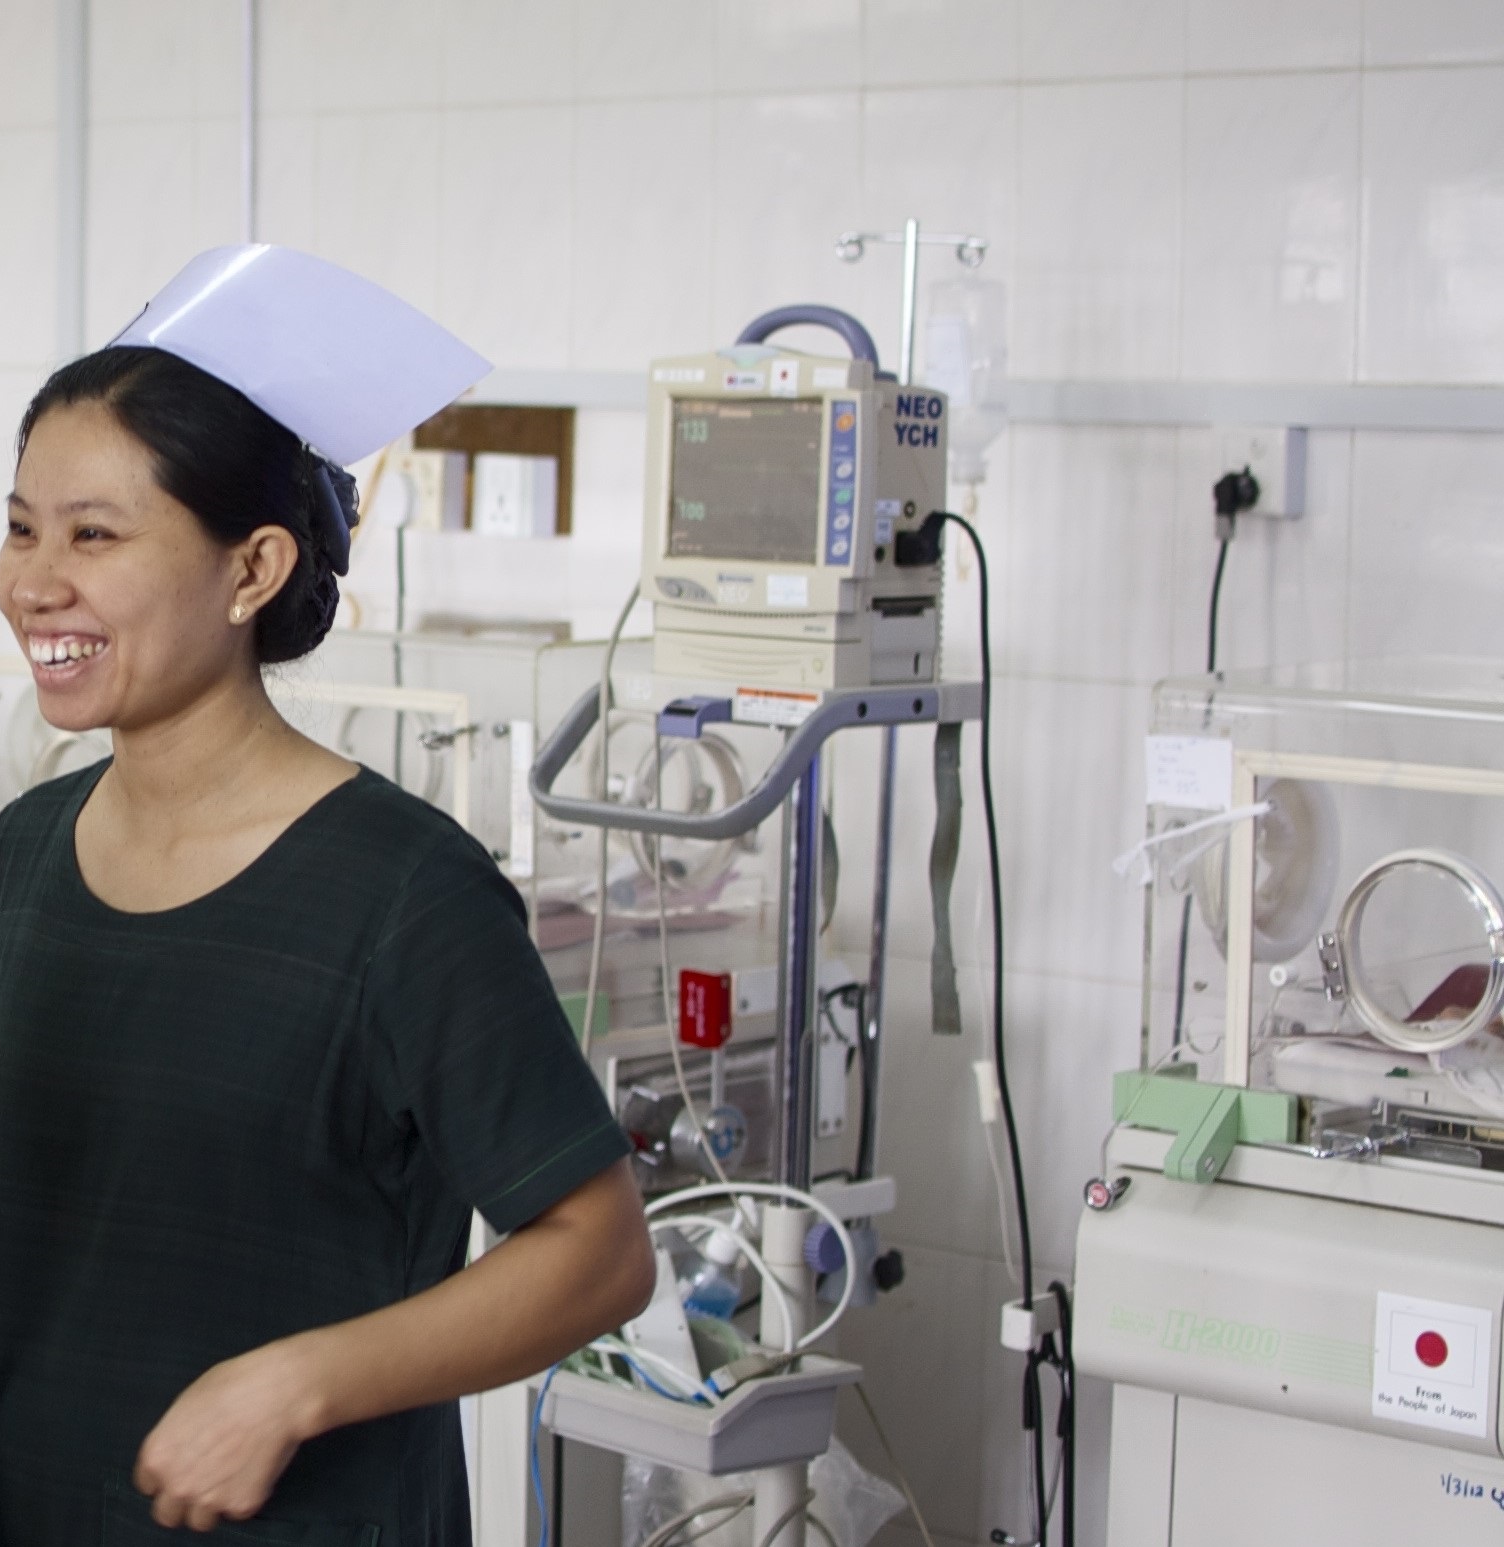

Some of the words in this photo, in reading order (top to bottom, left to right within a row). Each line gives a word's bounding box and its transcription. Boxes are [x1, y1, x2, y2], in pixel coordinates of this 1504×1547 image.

[897, 395, 942, 419] NEO
[894, 422, 938, 448] YCH
[1162, 1309, 1281, 1360] H-2000
[1377, 1393, 1393, 1404] the
[1398, 1396, 1428, 1411] People
[1435, 1404, 1447, 1415] of
[1450, 1406, 1477, 1420] Japan
[1415, 1386, 1442, 1401] From
